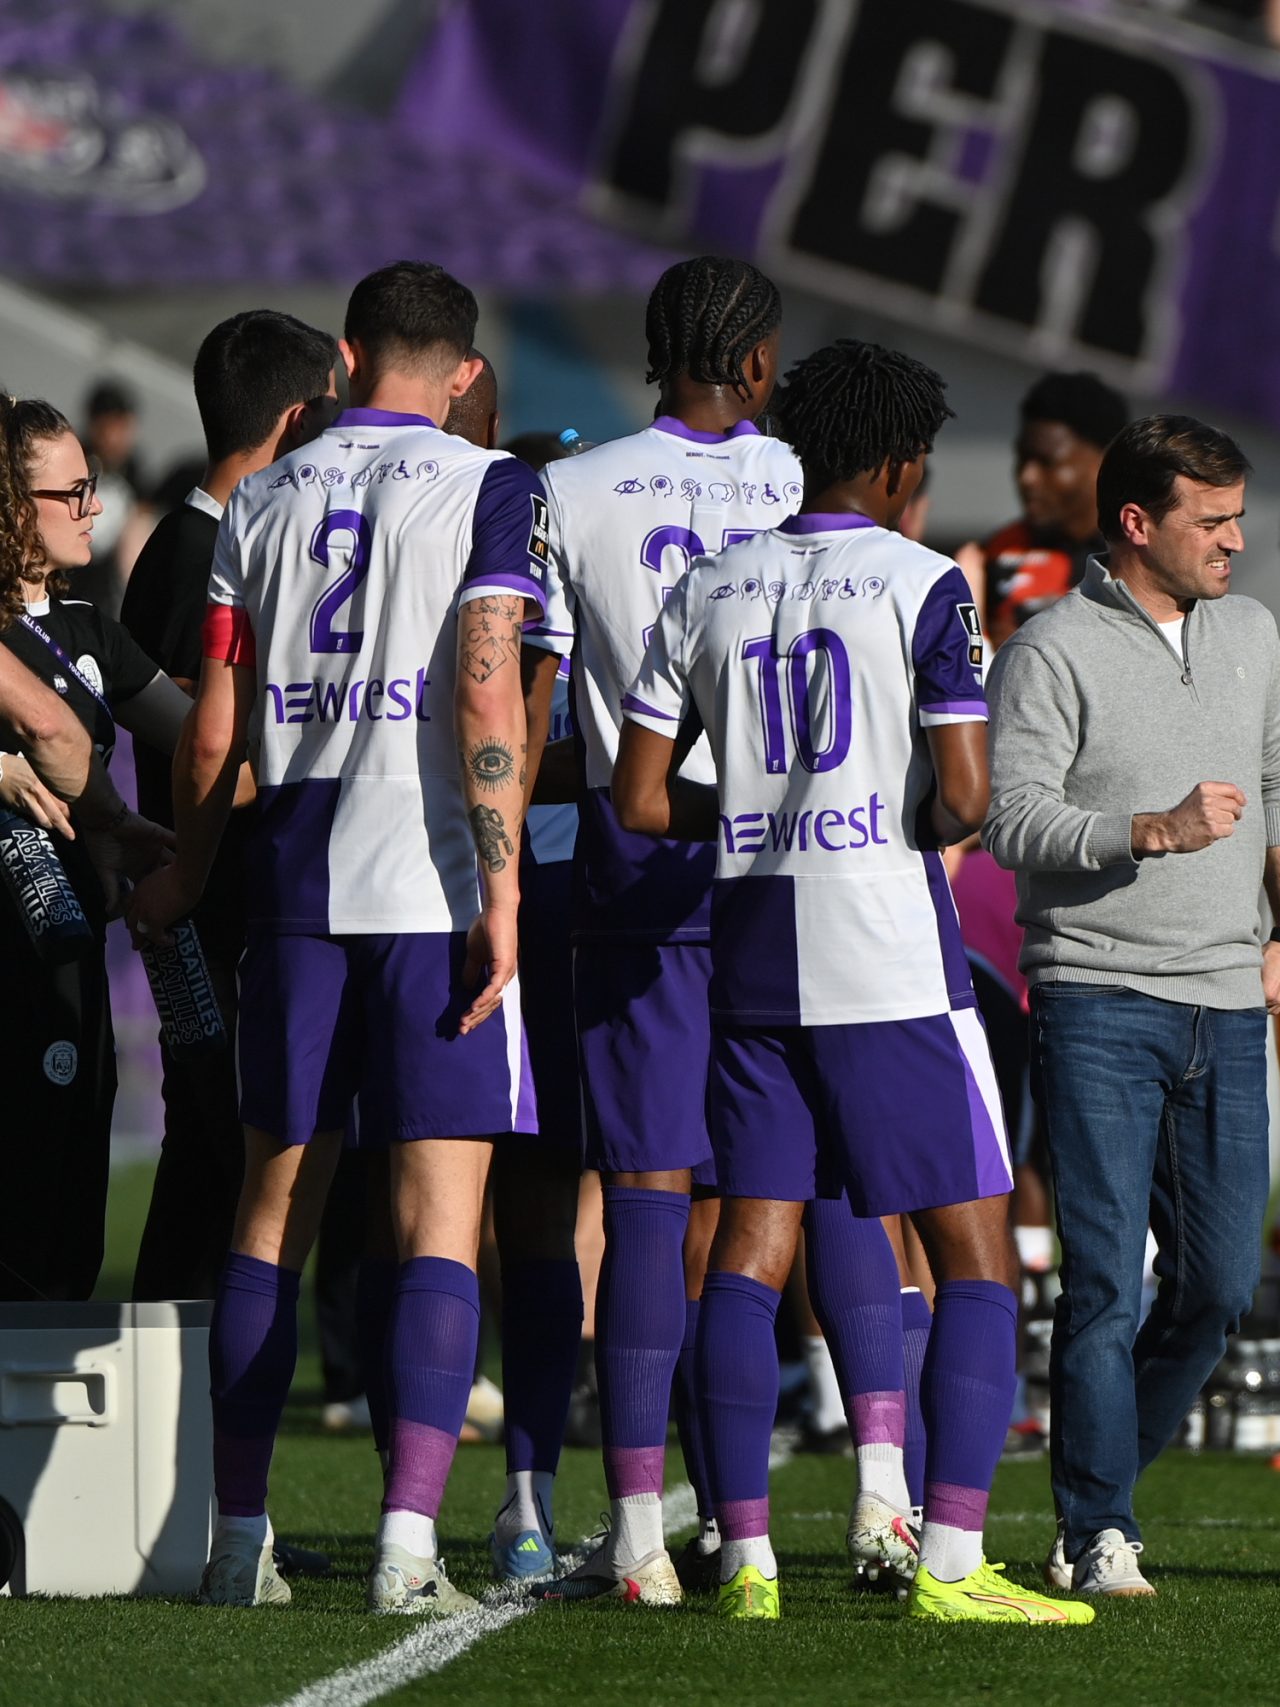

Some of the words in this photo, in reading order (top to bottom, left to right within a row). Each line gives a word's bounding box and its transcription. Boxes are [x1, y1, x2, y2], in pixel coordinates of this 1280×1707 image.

[600, 0, 1205, 370] PER
[34, 624, 52, 644] CLUB
[310, 509, 372, 653] 2
[741, 627, 852, 774] 10
[154, 943, 204, 1045] BATILLES
